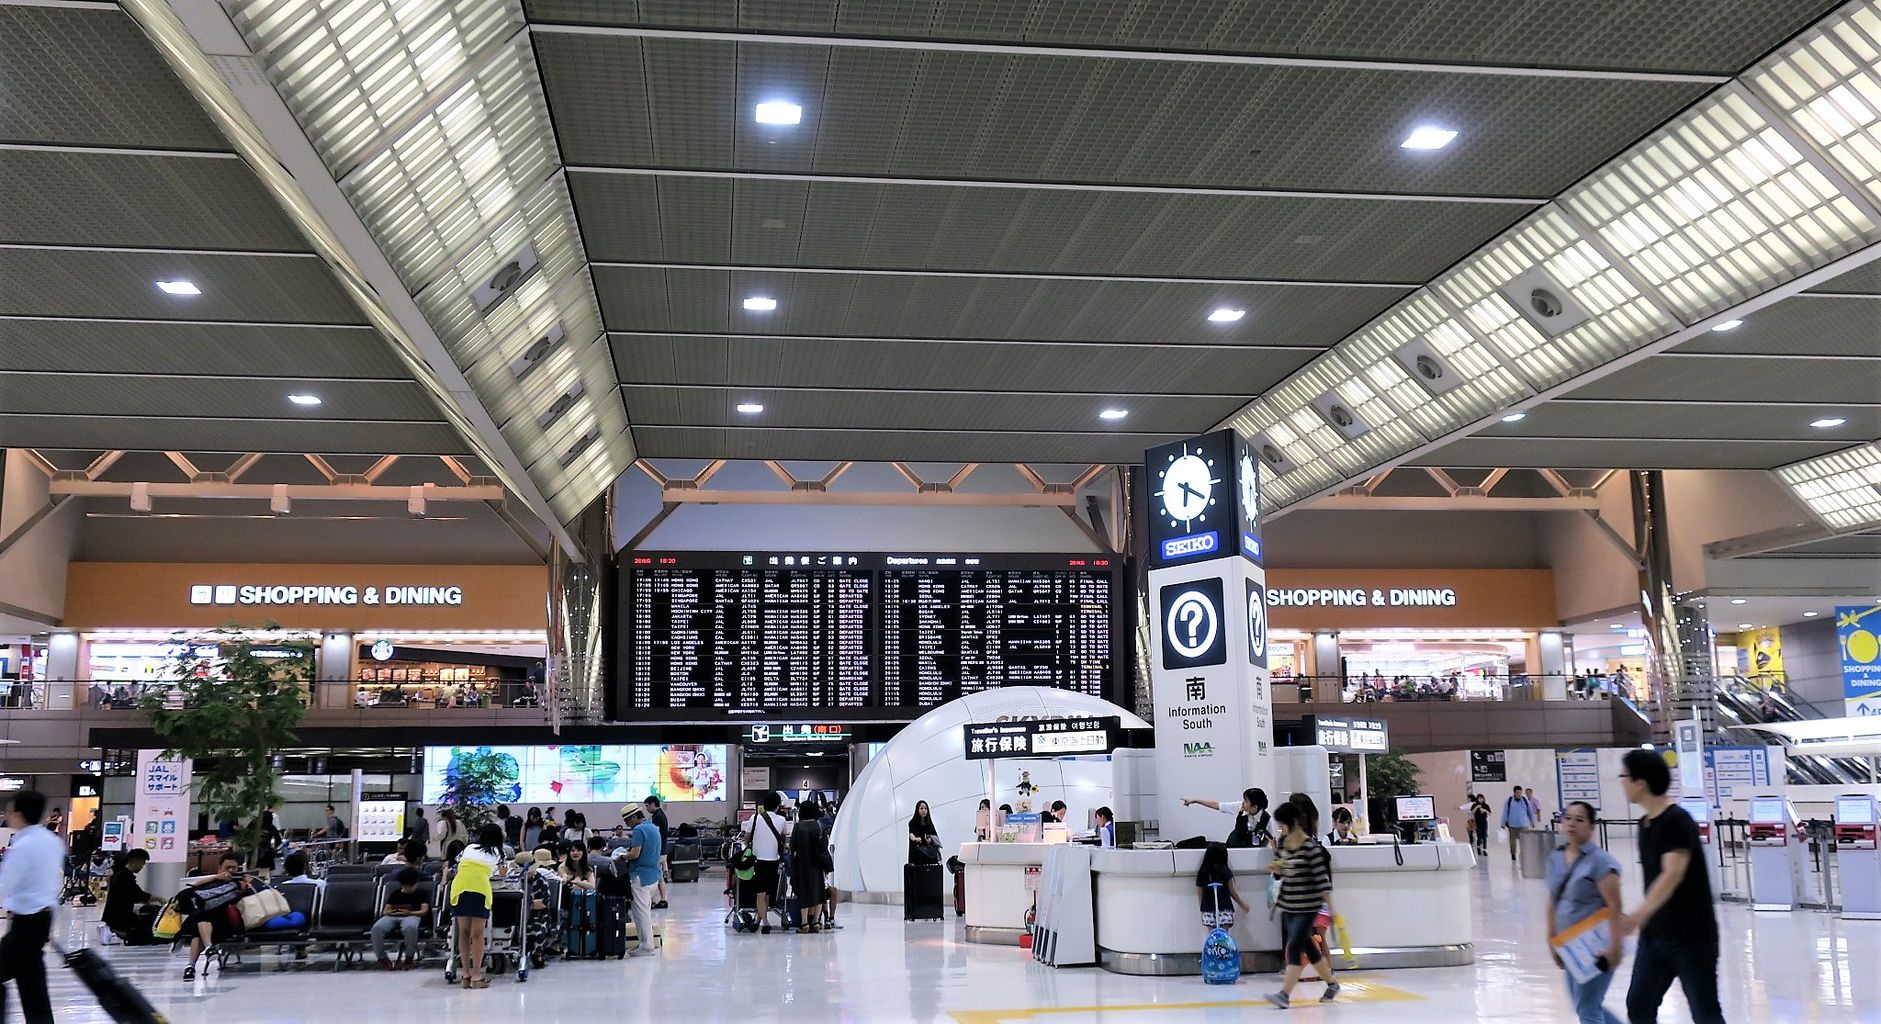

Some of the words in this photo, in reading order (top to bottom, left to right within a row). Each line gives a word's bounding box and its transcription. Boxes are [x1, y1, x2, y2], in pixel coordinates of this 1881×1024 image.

[1165, 535, 1214, 557] SEIKO
[887, 556, 928, 565] Departures
[239, 585, 358, 605] SHOPPING
[363, 585, 380, 604] &
[385, 586, 462, 604] DINING
[1266, 588, 1367, 607] SHOPPING
[1372, 589, 1386, 606] &
[1390, 589, 1456, 607] DINING
[1186, 676, 1206, 702] 南
[1168, 705, 1226, 717] Information
[1183, 718, 1212, 730] South
[971, 736, 1027, 753] 旅行保険
